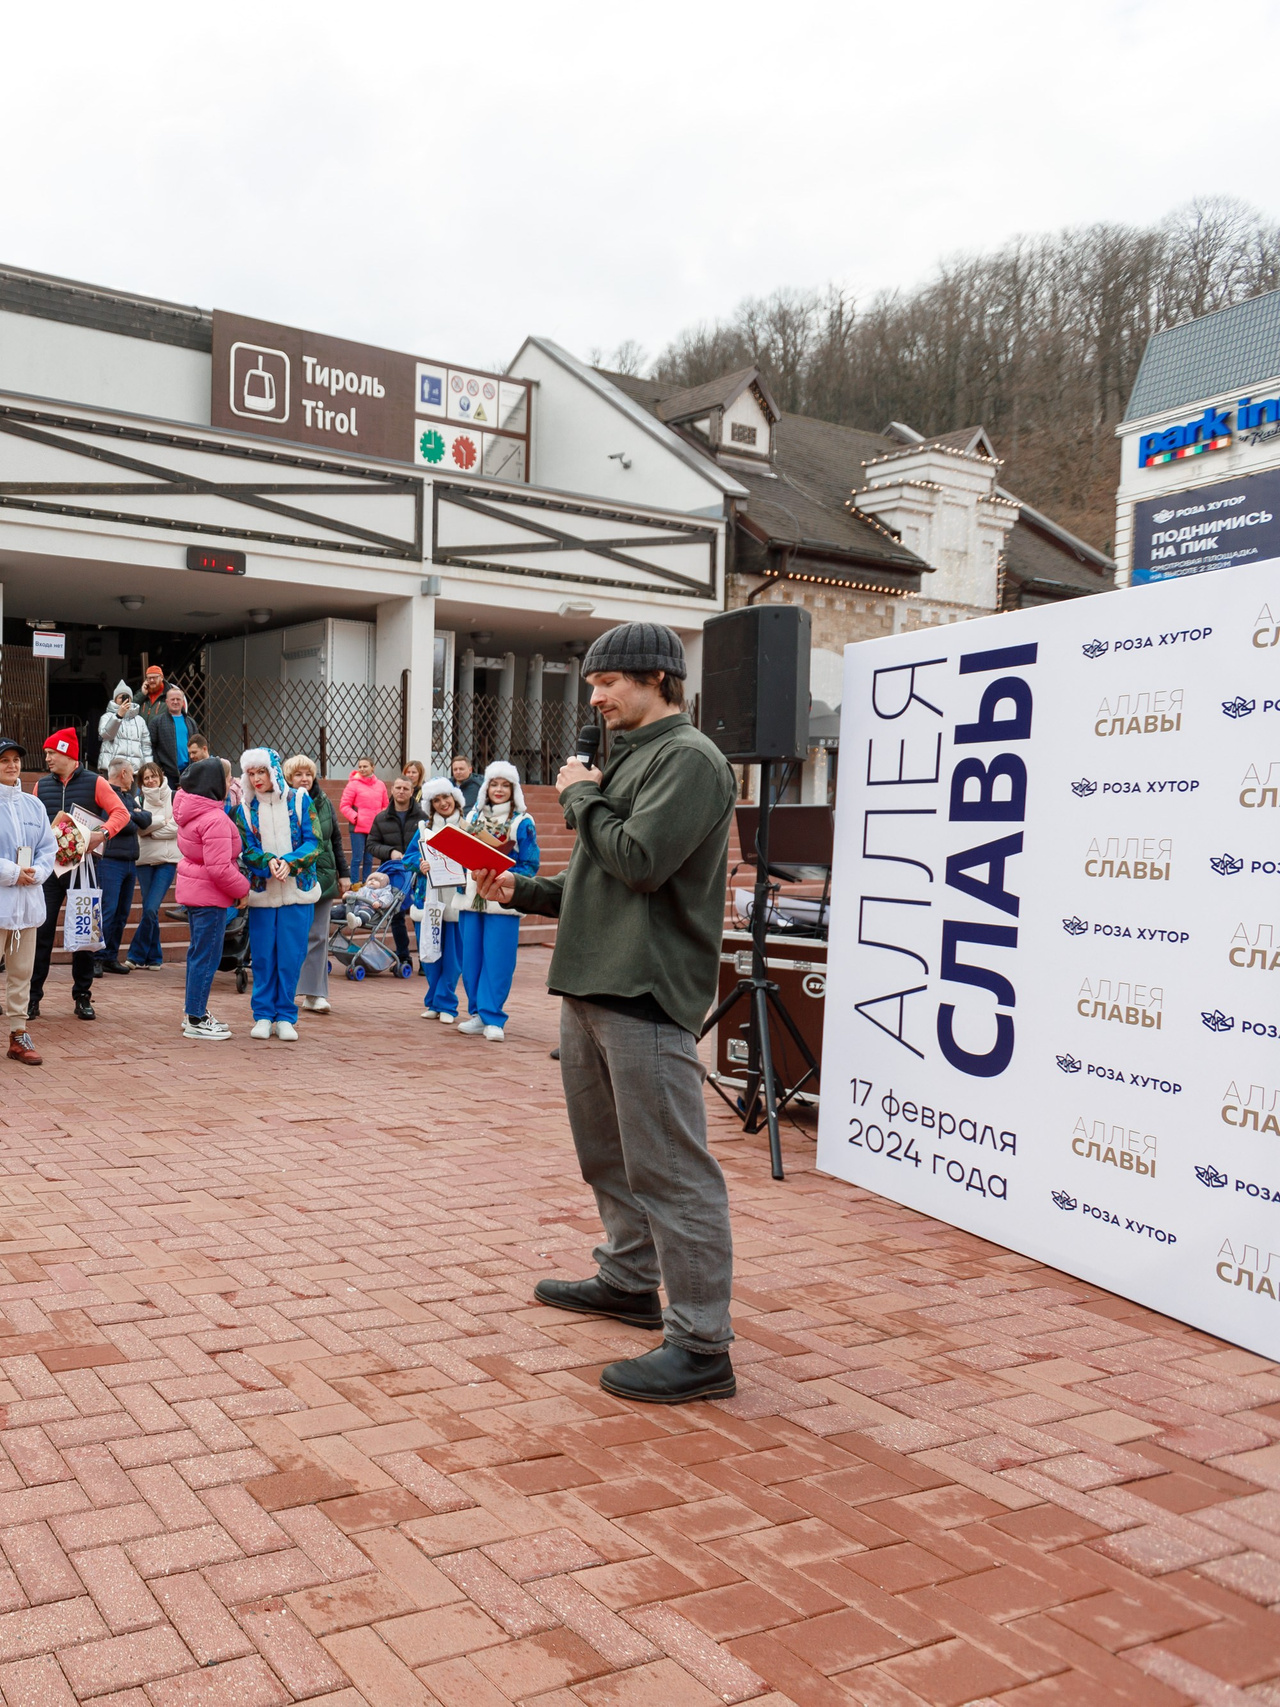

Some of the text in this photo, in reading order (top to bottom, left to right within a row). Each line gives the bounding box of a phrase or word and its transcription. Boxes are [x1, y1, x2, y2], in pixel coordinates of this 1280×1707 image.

[302, 355, 386, 398] Тироль
[301, 398, 358, 437] Tirol
[1138, 407, 1232, 469] park
[1175, 495, 1246, 518] РОЗА ХУТОР
[1151, 510, 1273, 546] ПОДНИМИСЬ
[1151, 536, 1219, 561] НА ПИК
[35, 640, 53, 649] Входа
[1114, 627, 1213, 652] РОЗА ХУТОР
[1095, 688, 1184, 718] АЛЛЕЯ
[1094, 712, 1182, 737] СЛАВЫ
[1102, 780, 1200, 794] РОЗА ХУТОР
[854, 657, 948, 1060] АЛЛЕЯ
[936, 641, 1039, 1078] СЛАВЫ
[1085, 837, 1173, 860] АЛЛЕЯ
[1084, 859, 1170, 881] СЛАВЫ
[75, 896, 91, 906] 20
[75, 906, 91, 916] 14
[428, 908, 441, 918] 20
[75, 916, 91, 926] 20
[75, 926, 91, 935] 24
[1093, 923, 1190, 944] РОЗА ХУТОР
[1078, 977, 1164, 1009] АЛЛЕЯ
[1077, 998, 1162, 1030] СЛАВЫ
[1087, 1063, 1182, 1095] РОЗА ХУТОР
[850, 1077, 1017, 1156] 17 февраля
[1072, 1116, 1157, 1158] АЛЛЕЯ
[848, 1118, 1007, 1201] 2024 года
[1071, 1137, 1156, 1179] СЛАВЫ
[1082, 1203, 1177, 1245] РОЗА ХУТОР
[1216, 1261, 1280, 1302] СЛА
